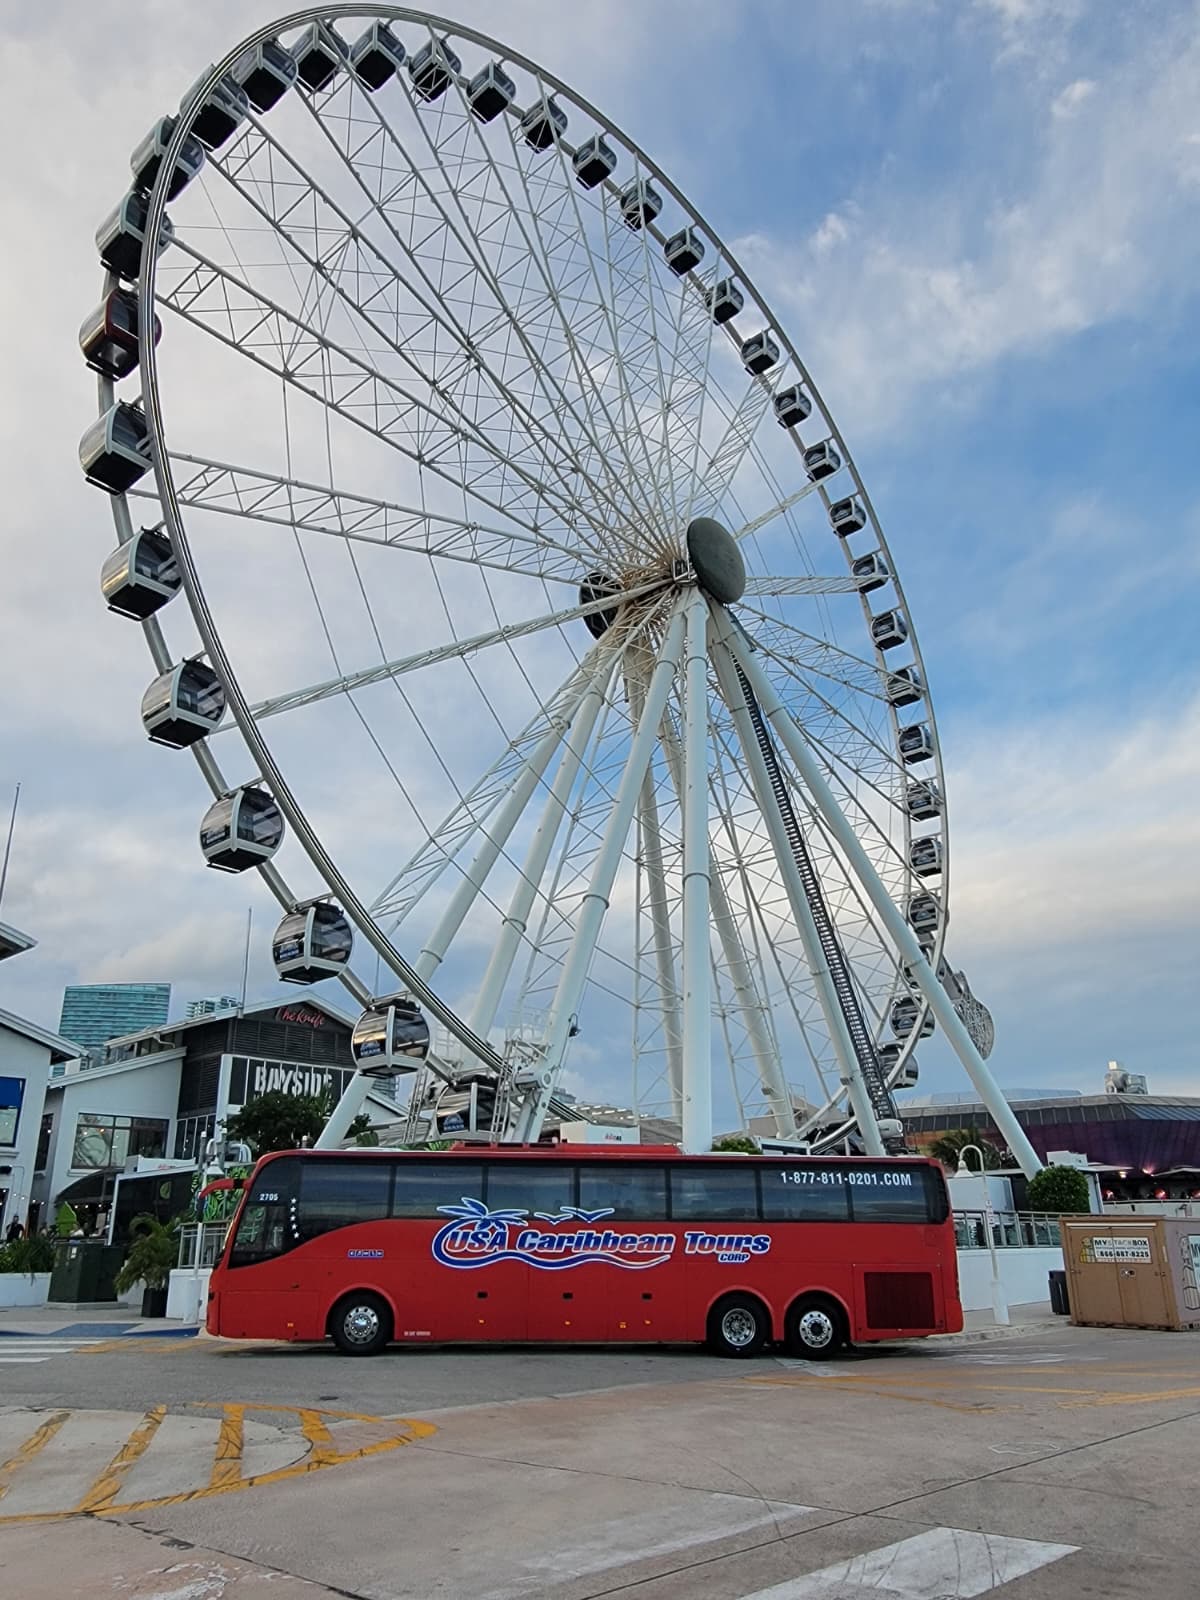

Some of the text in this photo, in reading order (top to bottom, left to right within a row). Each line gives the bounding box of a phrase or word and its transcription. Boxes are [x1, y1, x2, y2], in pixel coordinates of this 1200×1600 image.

[780, 1171, 912, 1186] 1-877-811-0201.COM
[259, 1193, 279, 1201] 2705
[446, 1229, 771, 1254] USA Caribbean Tours
[718, 1252, 750, 1263] CORP
